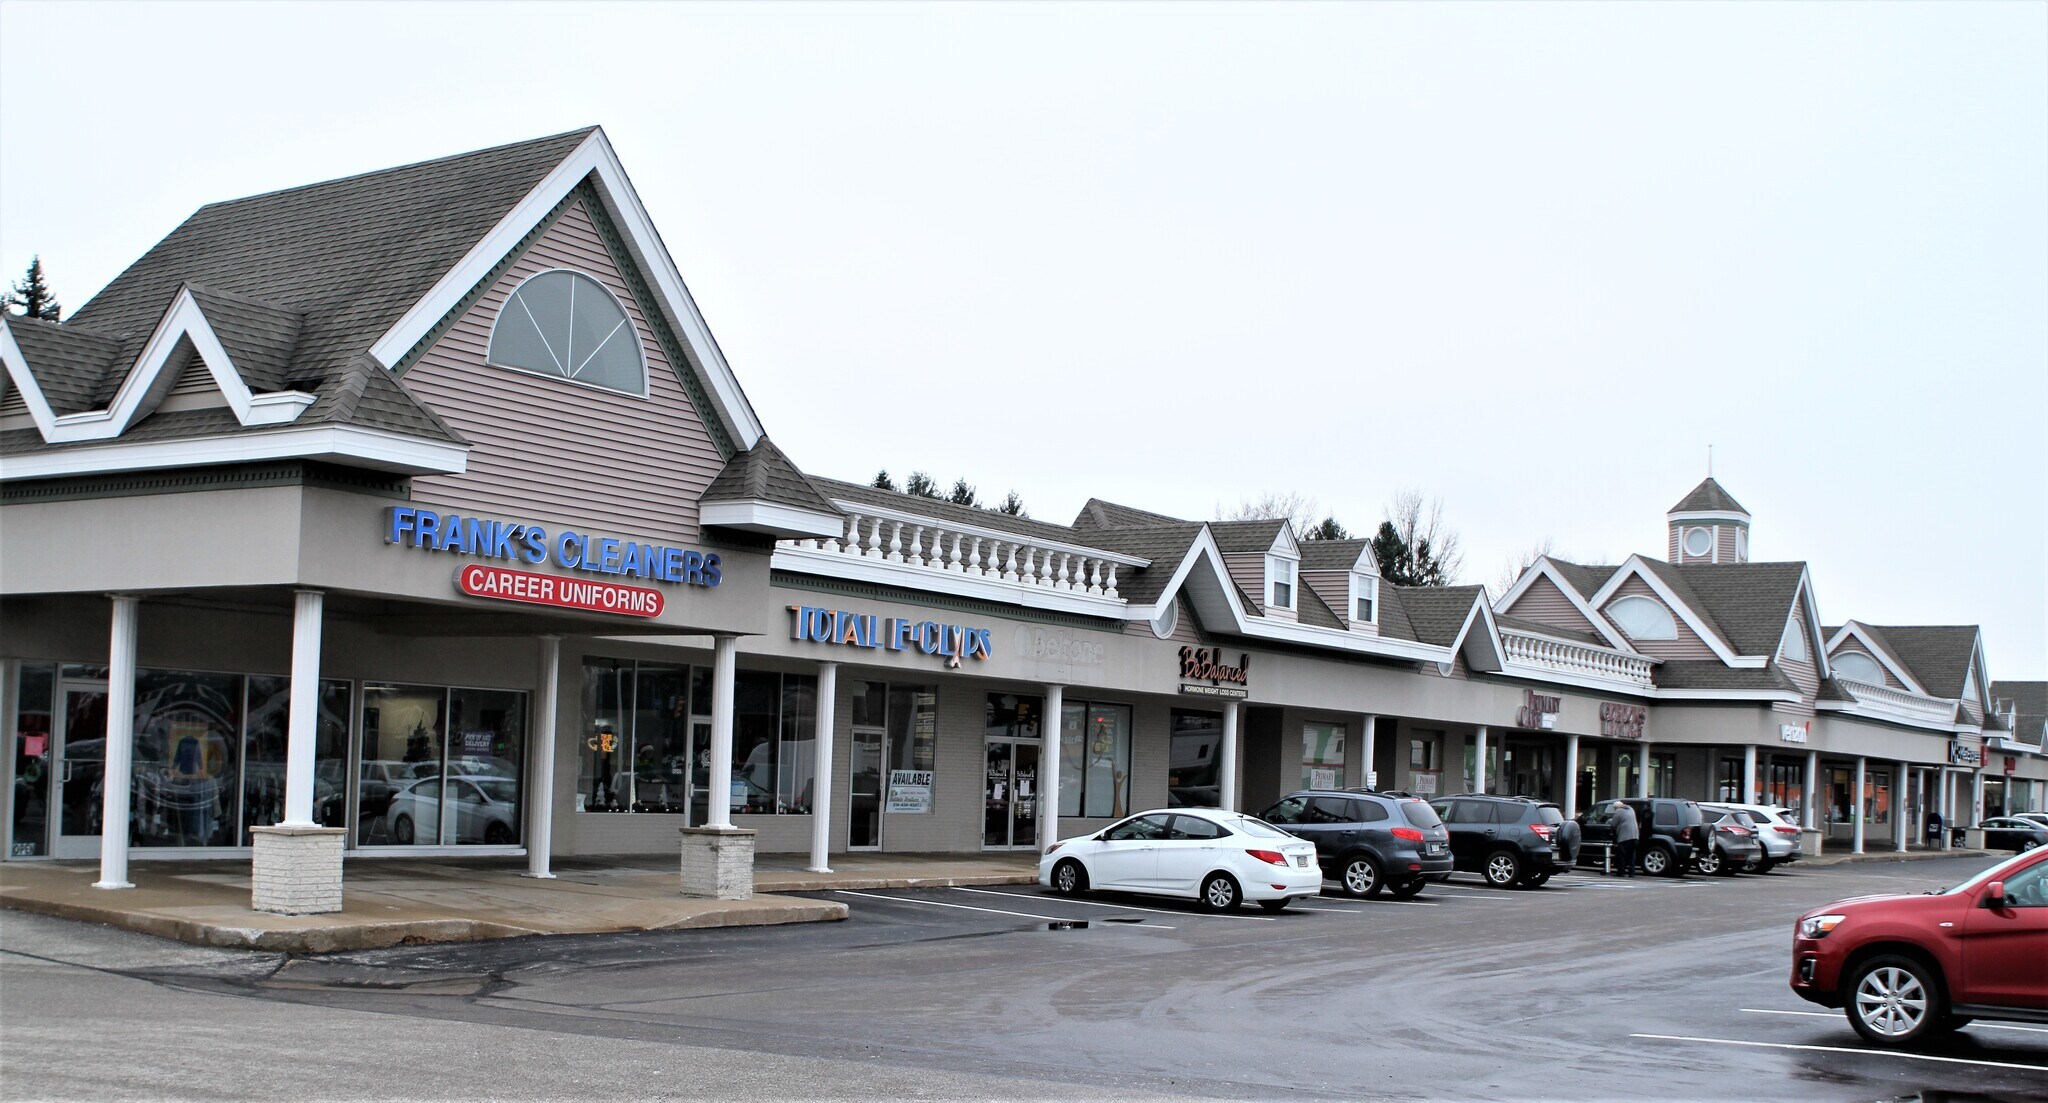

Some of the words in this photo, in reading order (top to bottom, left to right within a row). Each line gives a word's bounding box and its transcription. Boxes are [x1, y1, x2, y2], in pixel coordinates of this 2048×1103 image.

[391, 504, 548, 564] FRANK'S
[557, 531, 724, 588] CLEANERS
[468, 569, 555, 601] CAREER
[560, 580, 659, 614] UNIFORMS
[788, 605, 885, 650] TOTAL
[1184, 685, 1205, 694] HORMONE
[1205, 687, 1219, 695] WEIGHT
[1220, 688, 1230, 696] LOSS
[1229, 690, 1247, 698] CENTERS
[1780, 721, 1807, 743] verizon
[892, 772, 931, 786] AVAILABLE
[1311, 779, 1323, 789] CARE
[1315, 770, 1334, 781] PRIMARY
